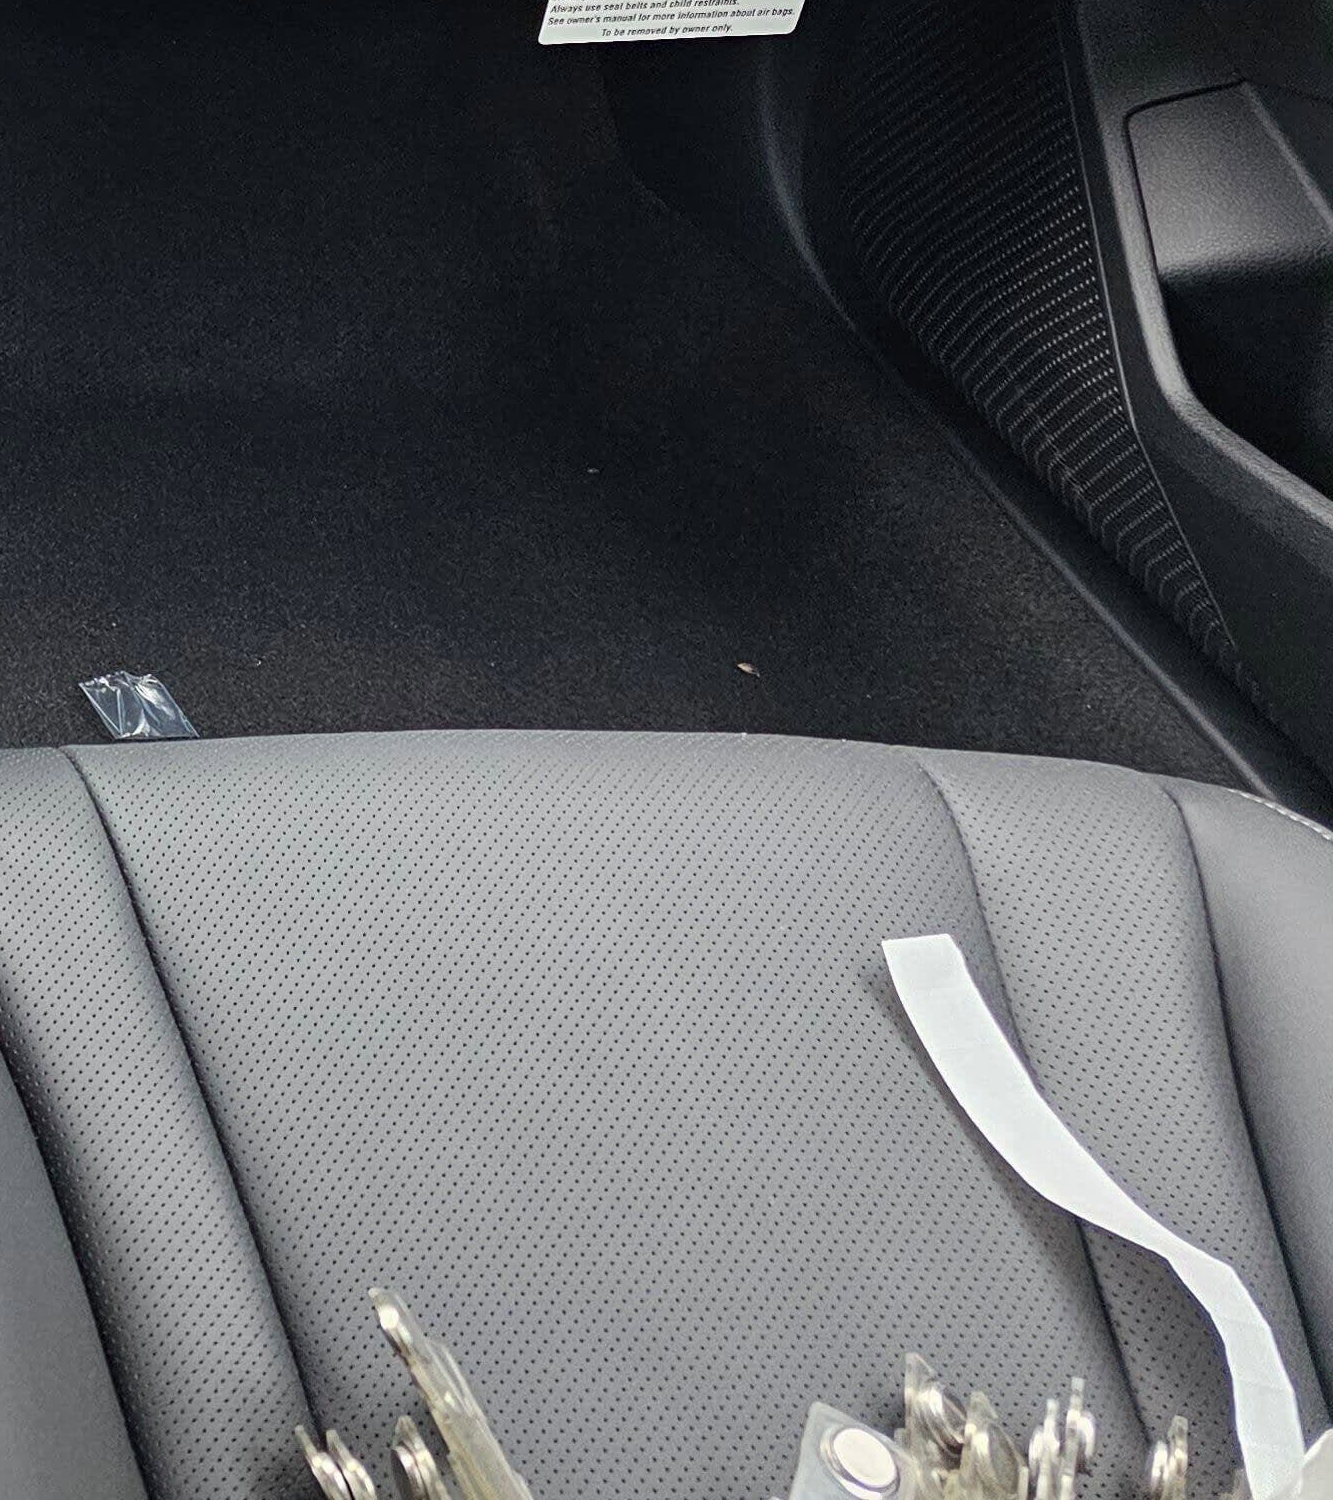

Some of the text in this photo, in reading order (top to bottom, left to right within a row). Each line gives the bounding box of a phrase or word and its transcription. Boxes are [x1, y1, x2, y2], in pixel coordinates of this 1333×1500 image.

[550, 4, 582, 14] Always
[585, 4, 602, 12] use
[603, 2, 624, 11] seat
[625, 1, 648, 10] belts
[649, 0, 667, 9] and
[669, 0, 693, 8] child
[547, 7, 795, 26] See owner's manual for more information about air bags.
[601, 23, 733, 37] To be removed by owner only.
